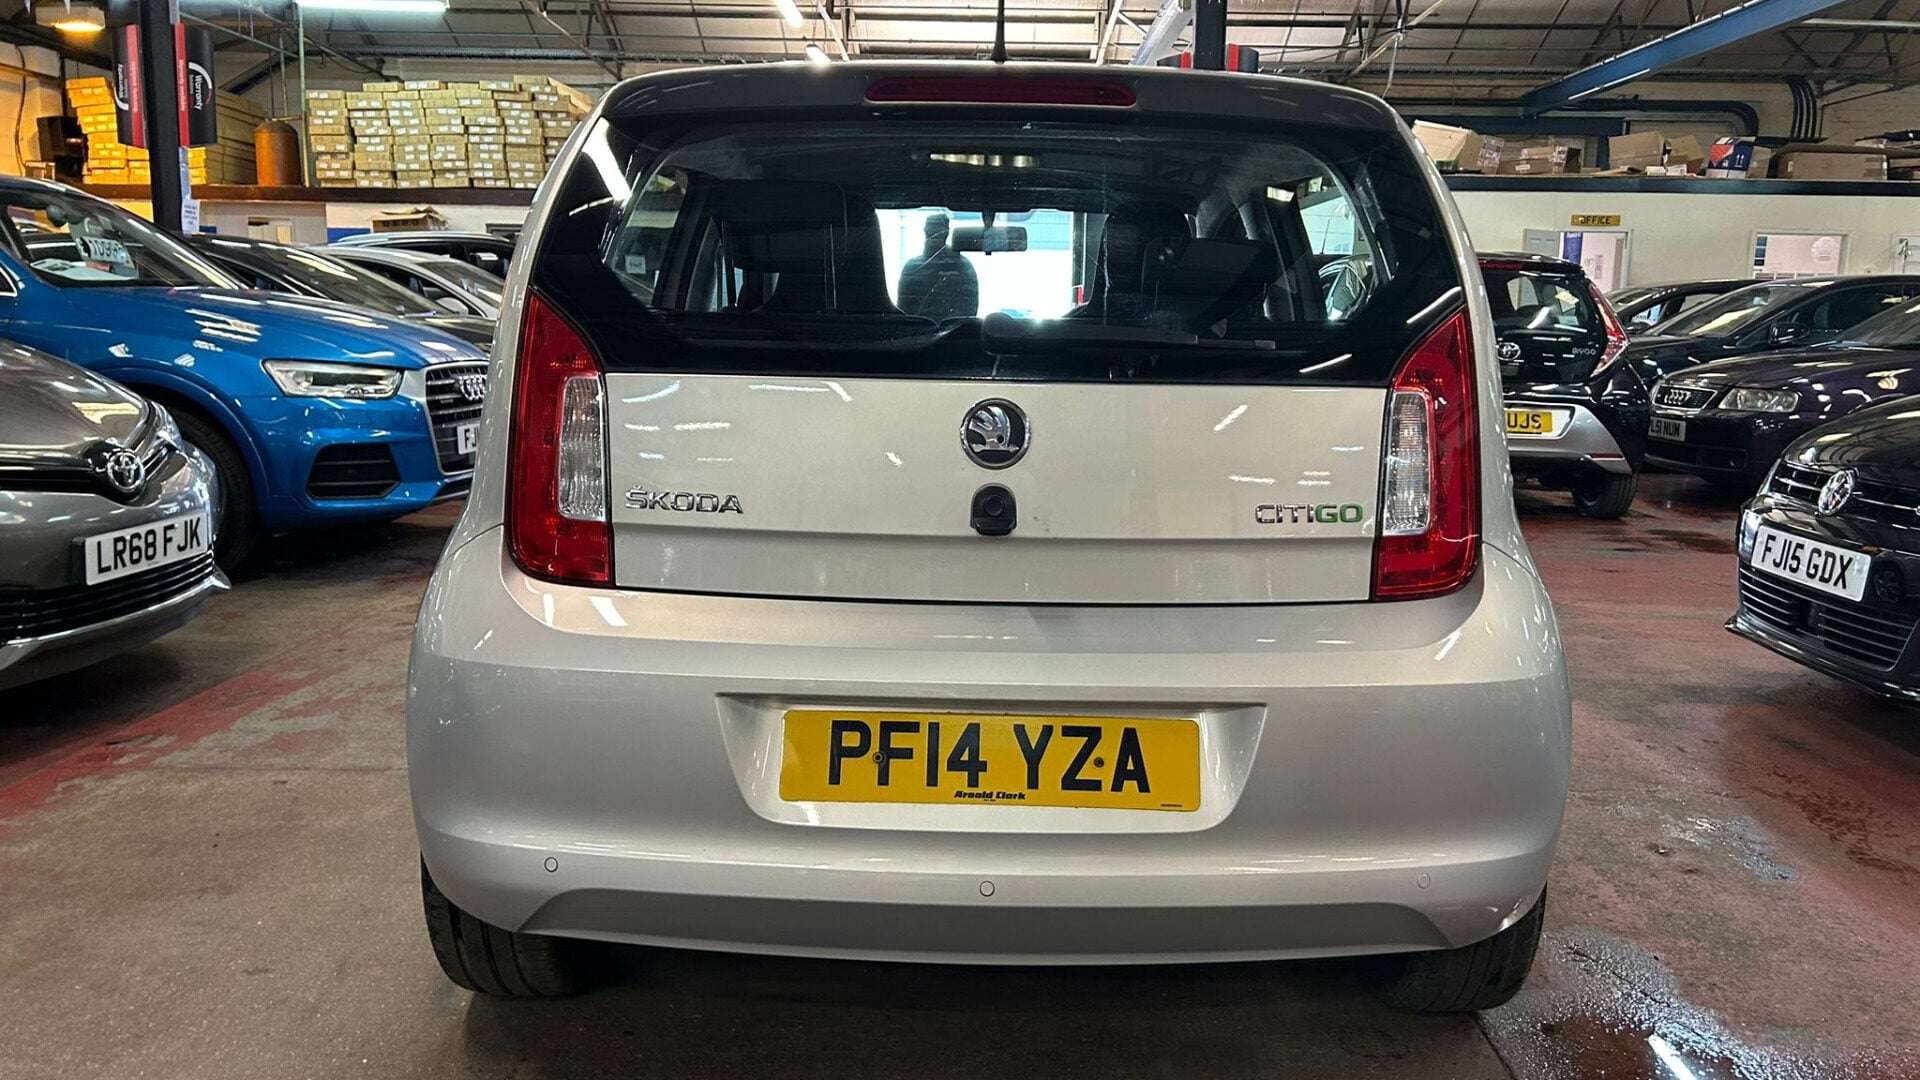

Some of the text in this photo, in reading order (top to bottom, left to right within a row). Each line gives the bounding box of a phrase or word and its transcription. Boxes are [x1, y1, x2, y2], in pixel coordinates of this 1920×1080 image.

[194, 74, 204, 111] Warranty
[1579, 215, 1612, 225] OFFICE
[1507, 412, 1542, 429] UJS
[625, 484, 743, 514] ŠKODA
[1255, 504, 1363, 523] CITIGO
[97, 517, 201, 574] LR68 FJK
[1761, 534, 1853, 589] FJ15 GDX
[828, 719, 1152, 793] PF14 YZA
[953, 790, 993, 799] Arnold
[996, 791, 1026, 800] Clark
